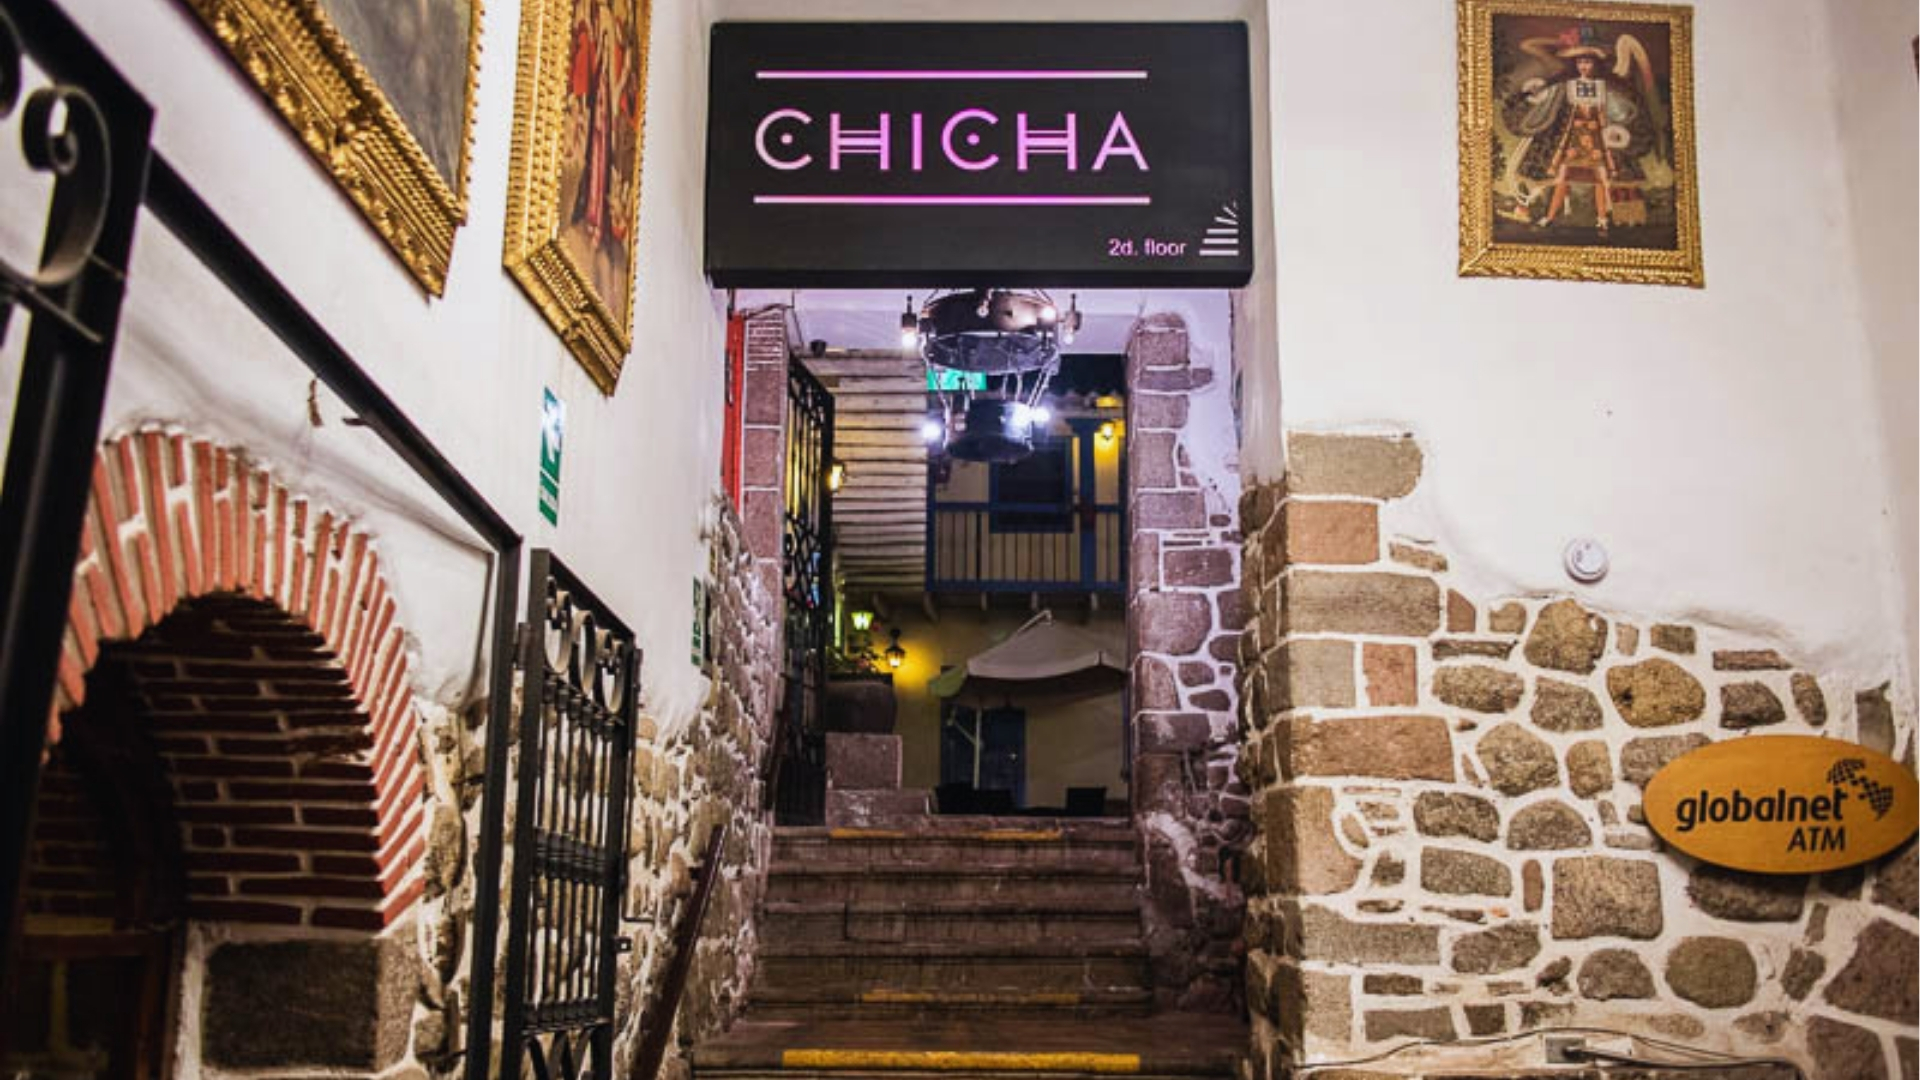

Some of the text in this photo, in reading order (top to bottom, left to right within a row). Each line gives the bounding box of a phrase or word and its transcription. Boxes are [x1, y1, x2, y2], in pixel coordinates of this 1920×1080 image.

[754, 108, 1150, 171] CHICHA
[1109, 238, 1187, 256] 2d. floor
[1676, 787, 1847, 831] globalnet
[1787, 828, 1845, 851] ATM
